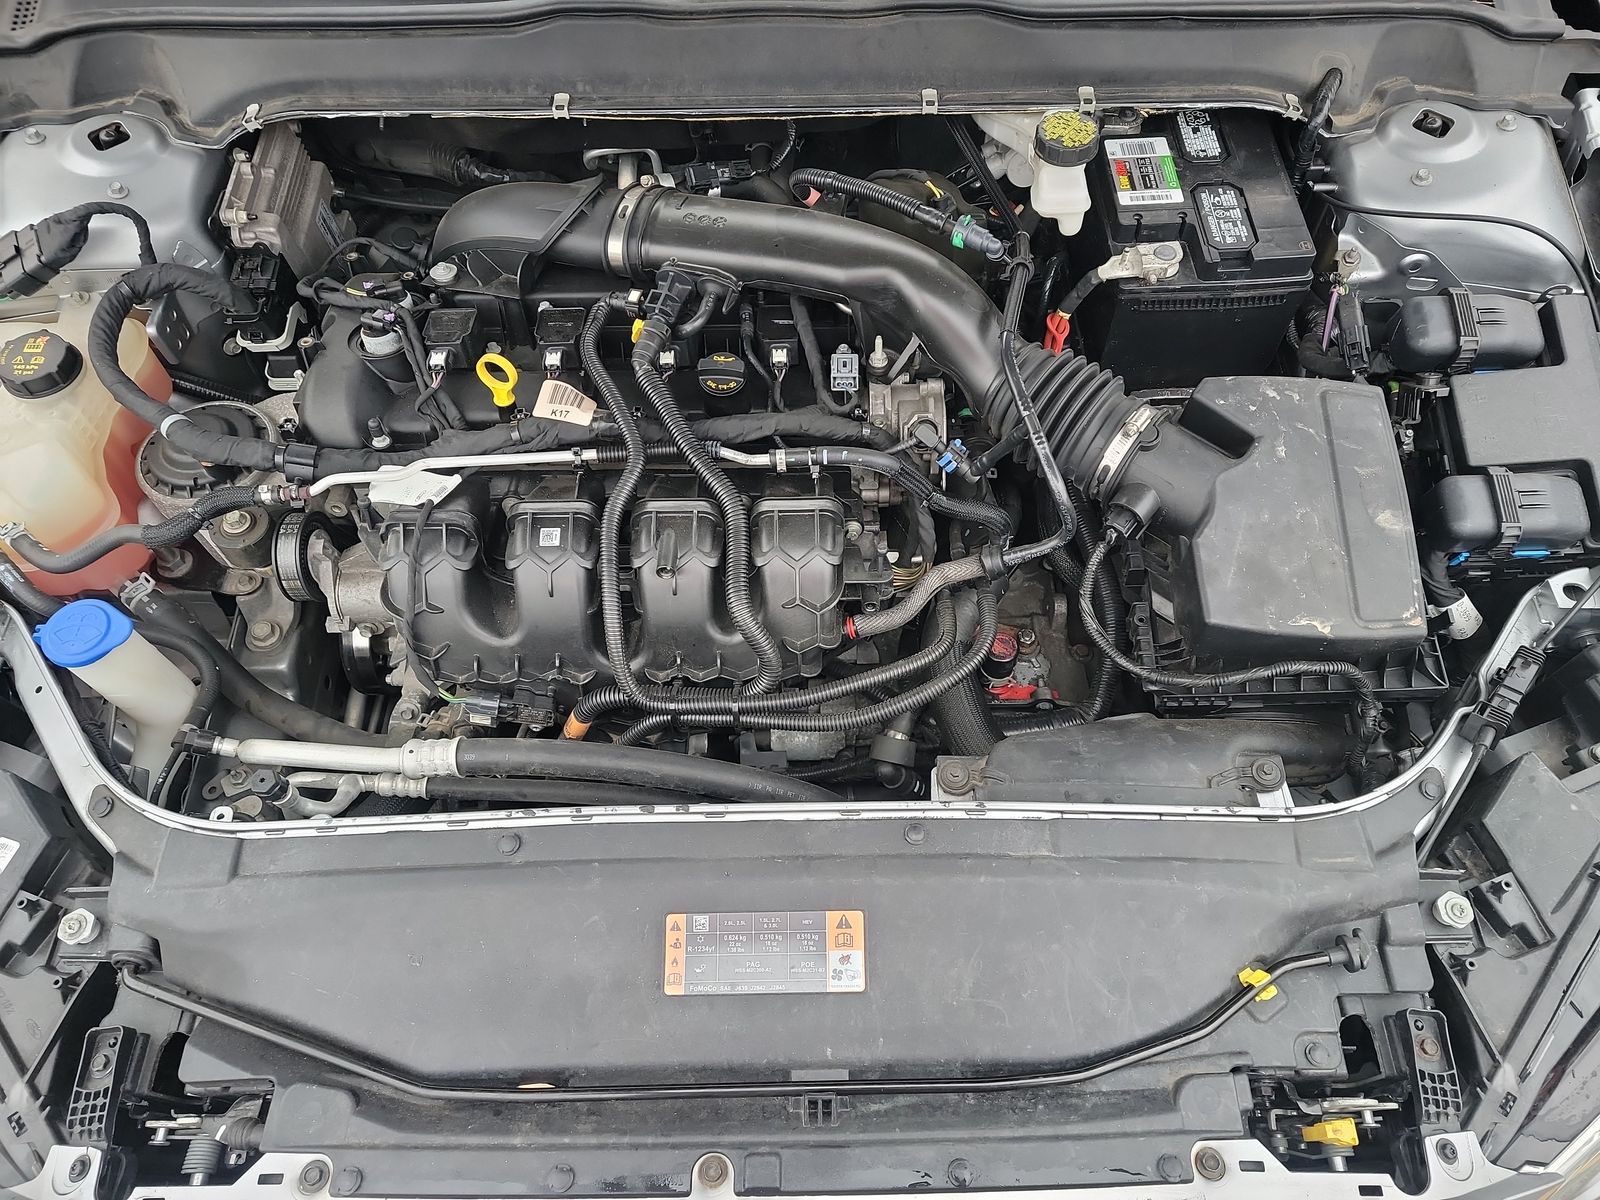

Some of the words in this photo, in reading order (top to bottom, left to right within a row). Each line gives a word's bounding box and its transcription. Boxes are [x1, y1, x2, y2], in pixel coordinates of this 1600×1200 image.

[1200, 192, 1211, 211] POISON
[1207, 215, 1219, 236] DANGER
[550, 408, 570, 418] K17
